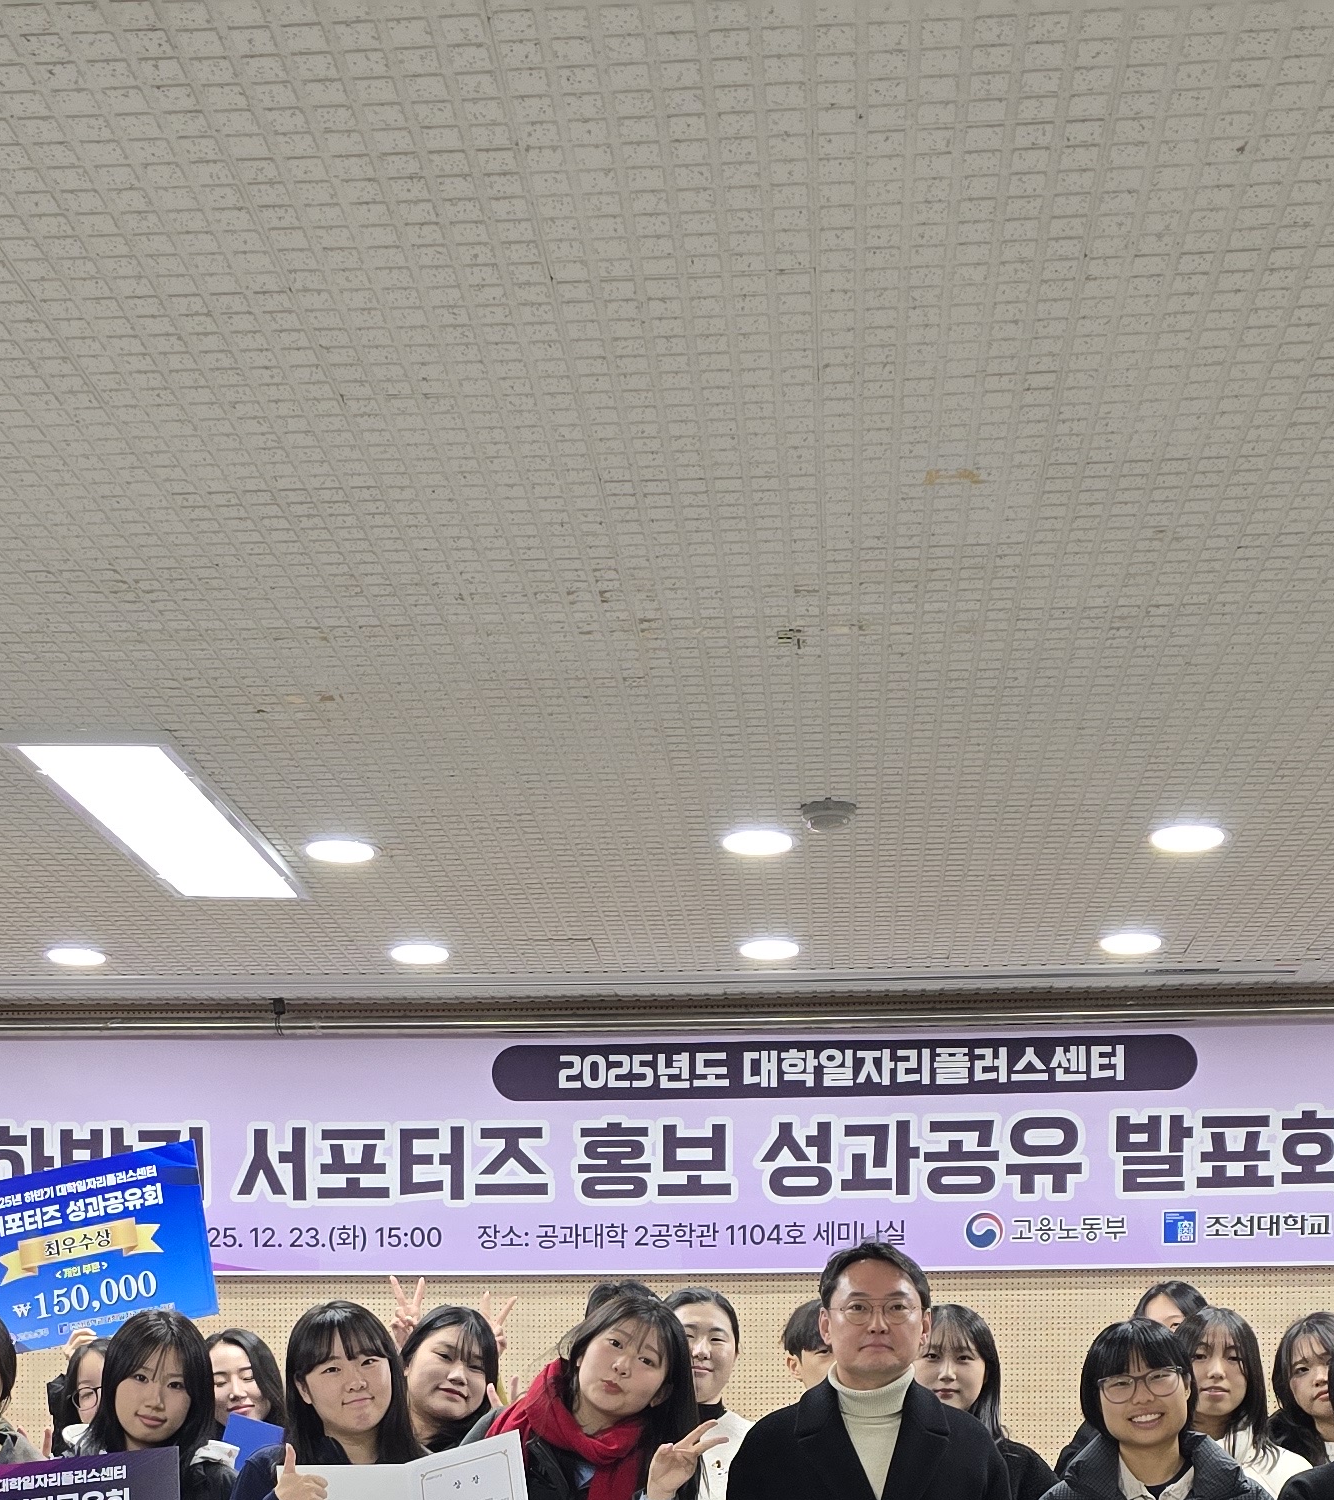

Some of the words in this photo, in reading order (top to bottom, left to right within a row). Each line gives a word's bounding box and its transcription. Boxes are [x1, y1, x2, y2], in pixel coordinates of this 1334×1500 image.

[558, 1052, 730, 1089] 2025년도
[743, 1044, 1125, 1088] 대학일자리플러스센터
[237, 1126, 549, 1201] 서포터즈
[577, 1122, 732, 1199] 홍보
[760, 1116, 1083, 1198] 성과공유
[24, 1188, 55, 1204] 하반기
[56, 1165, 157, 1197] 대학일자리플러스센터
[66, 1183, 164, 1222] 성과공유회
[44, 1229, 111, 1257] 최우수상
[250, 1227, 283, 1248] 12.
[289, 1225, 368, 1253] 23.(화)
[375, 1226, 443, 1248] 15:00
[476, 1224, 530, 1249] 장소:
[535, 1222, 627, 1251] 공과대학
[634, 1221, 719, 1250] 2공학관
[725, 1221, 807, 1246] 1104호
[813, 1220, 905, 1246] 세미나실
[1011, 1215, 1128, 1242] 고용노동부
[1205, 1212, 1332, 1239] 조선대학교
